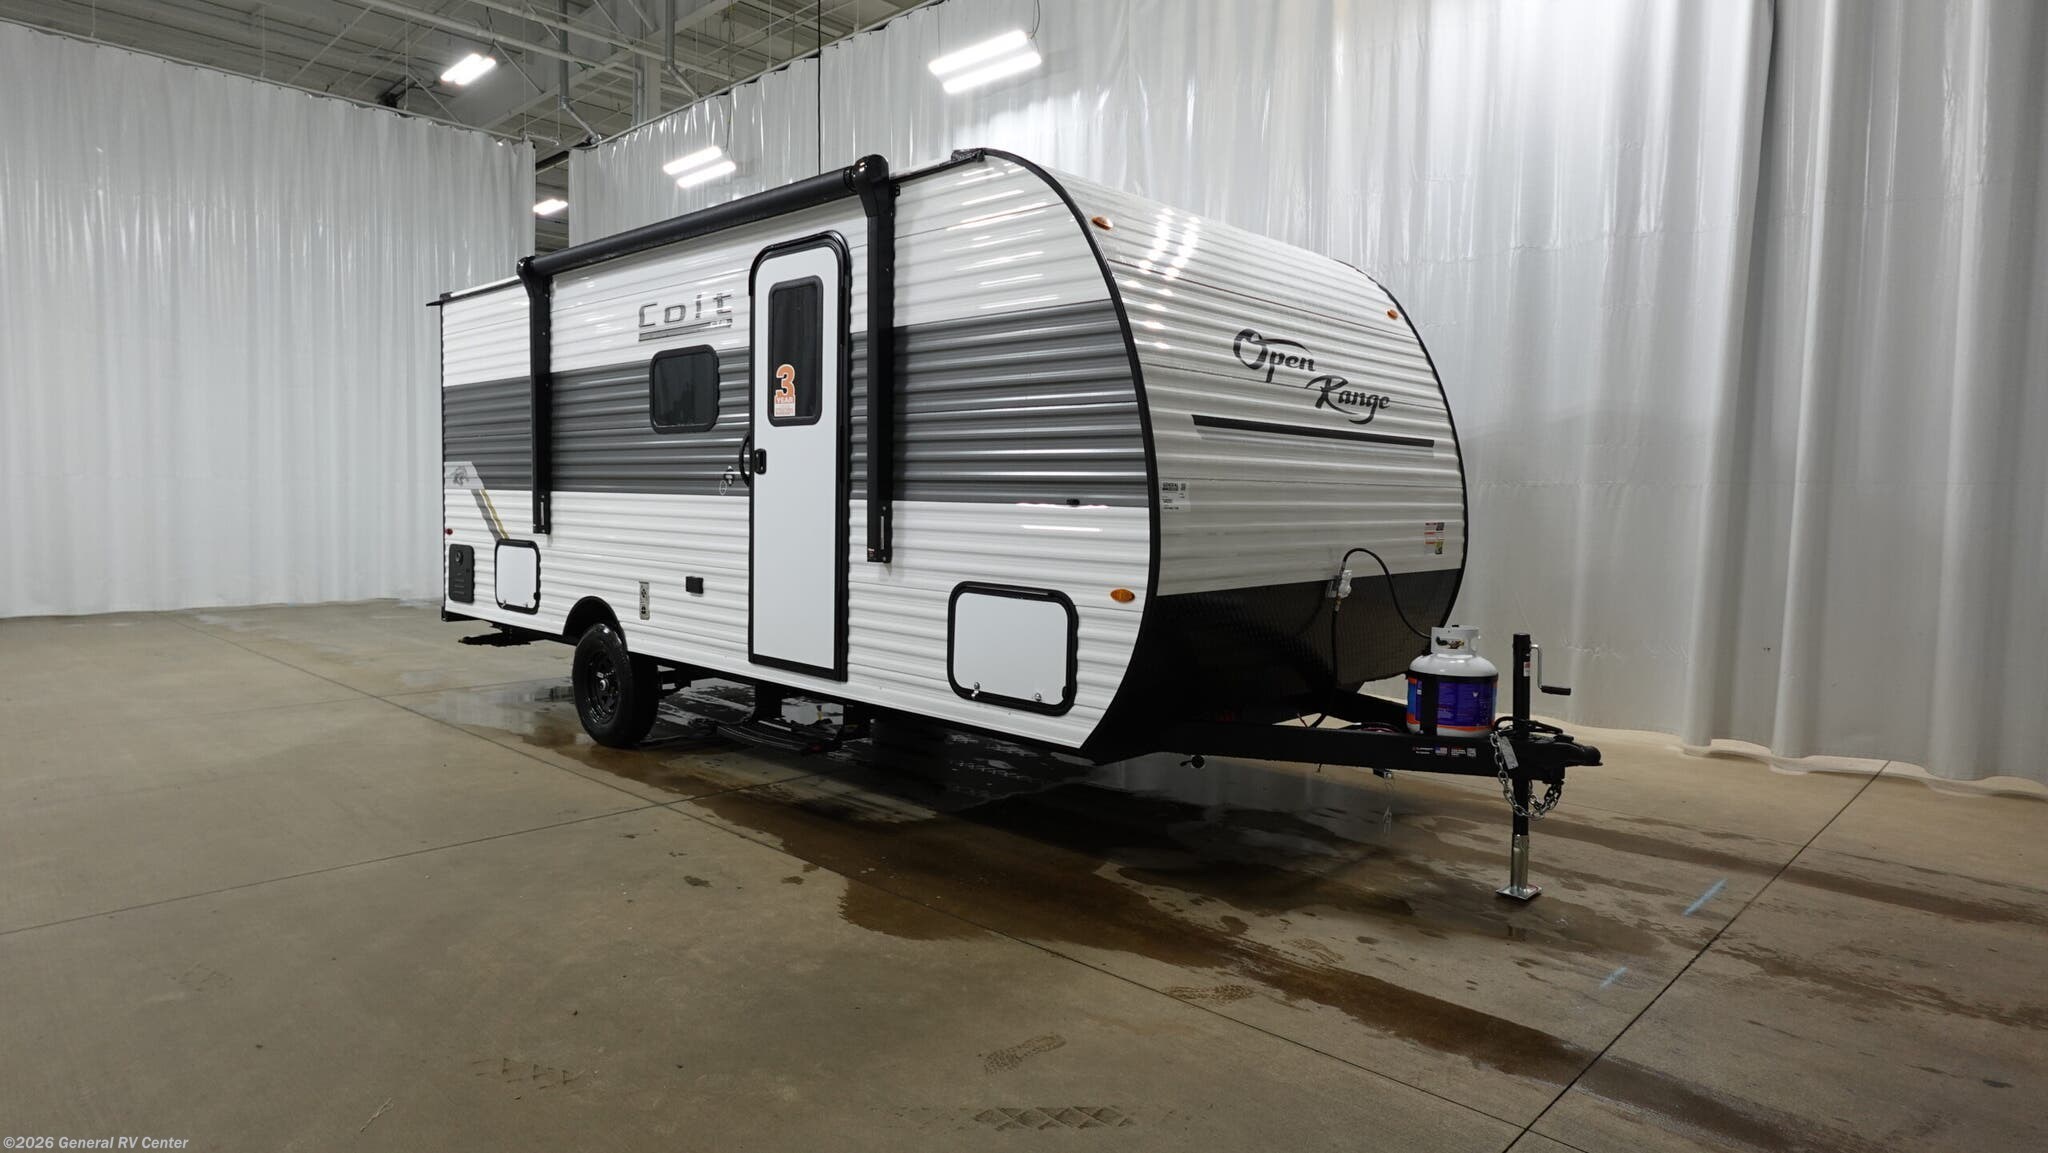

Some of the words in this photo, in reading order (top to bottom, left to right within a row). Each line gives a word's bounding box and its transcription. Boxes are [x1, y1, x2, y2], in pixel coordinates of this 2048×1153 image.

[638, 293, 732, 328] Colt
[1233, 328, 1316, 383] Open
[775, 363, 796, 398] 3
[1304, 374, 1391, 425] Range
